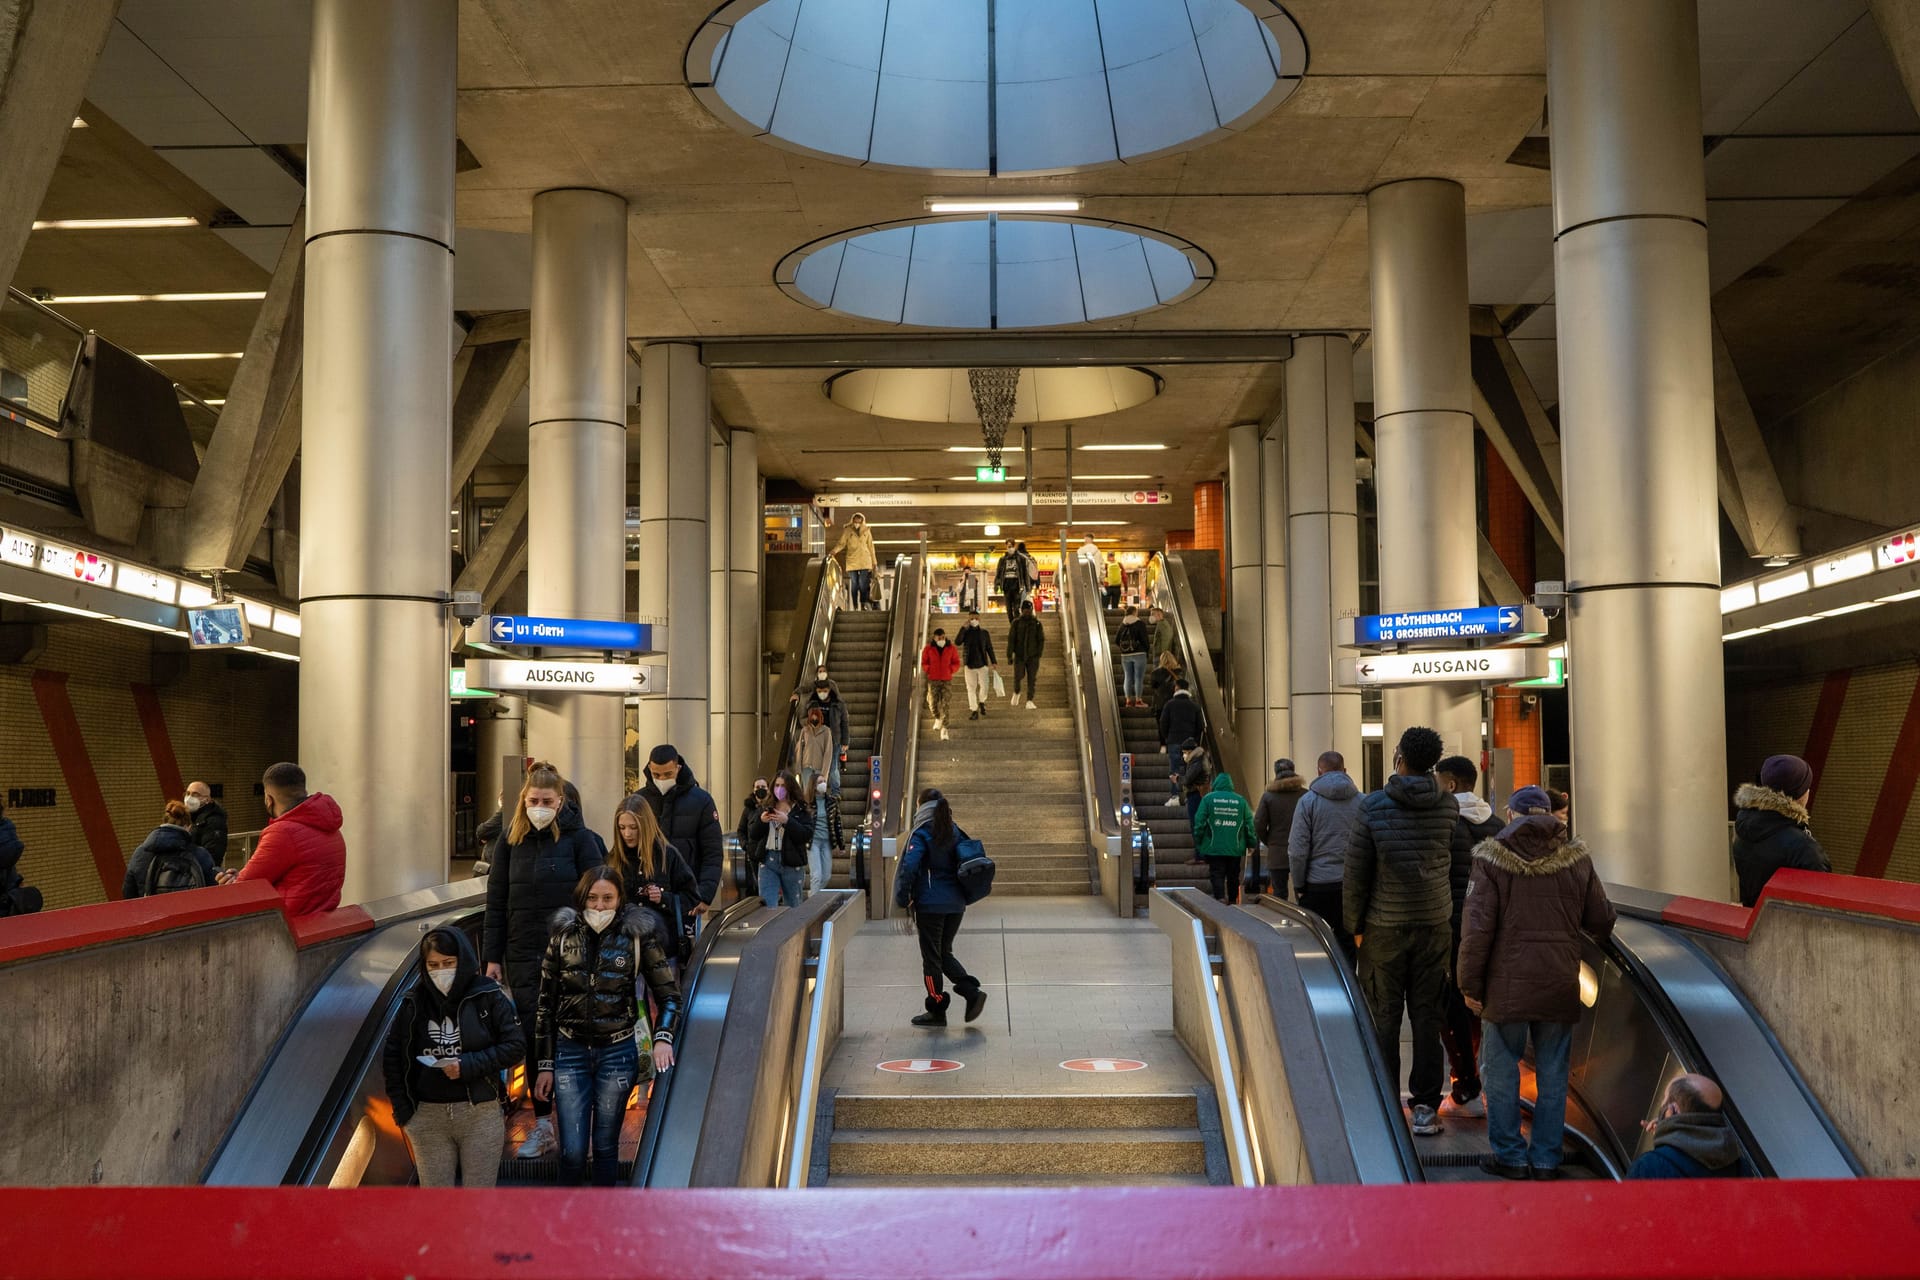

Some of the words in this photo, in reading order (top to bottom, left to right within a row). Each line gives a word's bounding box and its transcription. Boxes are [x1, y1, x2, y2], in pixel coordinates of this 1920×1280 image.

[11, 539, 58, 565] ALTSTADT
[1379, 616, 1393, 627] U2
[1395, 612, 1462, 626] RÖTHENBACH
[516, 625, 529, 636] U1
[533, 623, 564, 637] FÜRTH
[1380, 629, 1393, 640] U3
[1396, 626, 1449, 639] GROSSREUTH
[1460, 624, 1488, 635] SCHW.
[1412, 658, 1490, 674] AUSGANG
[526, 669, 595, 683] AUSGANG
